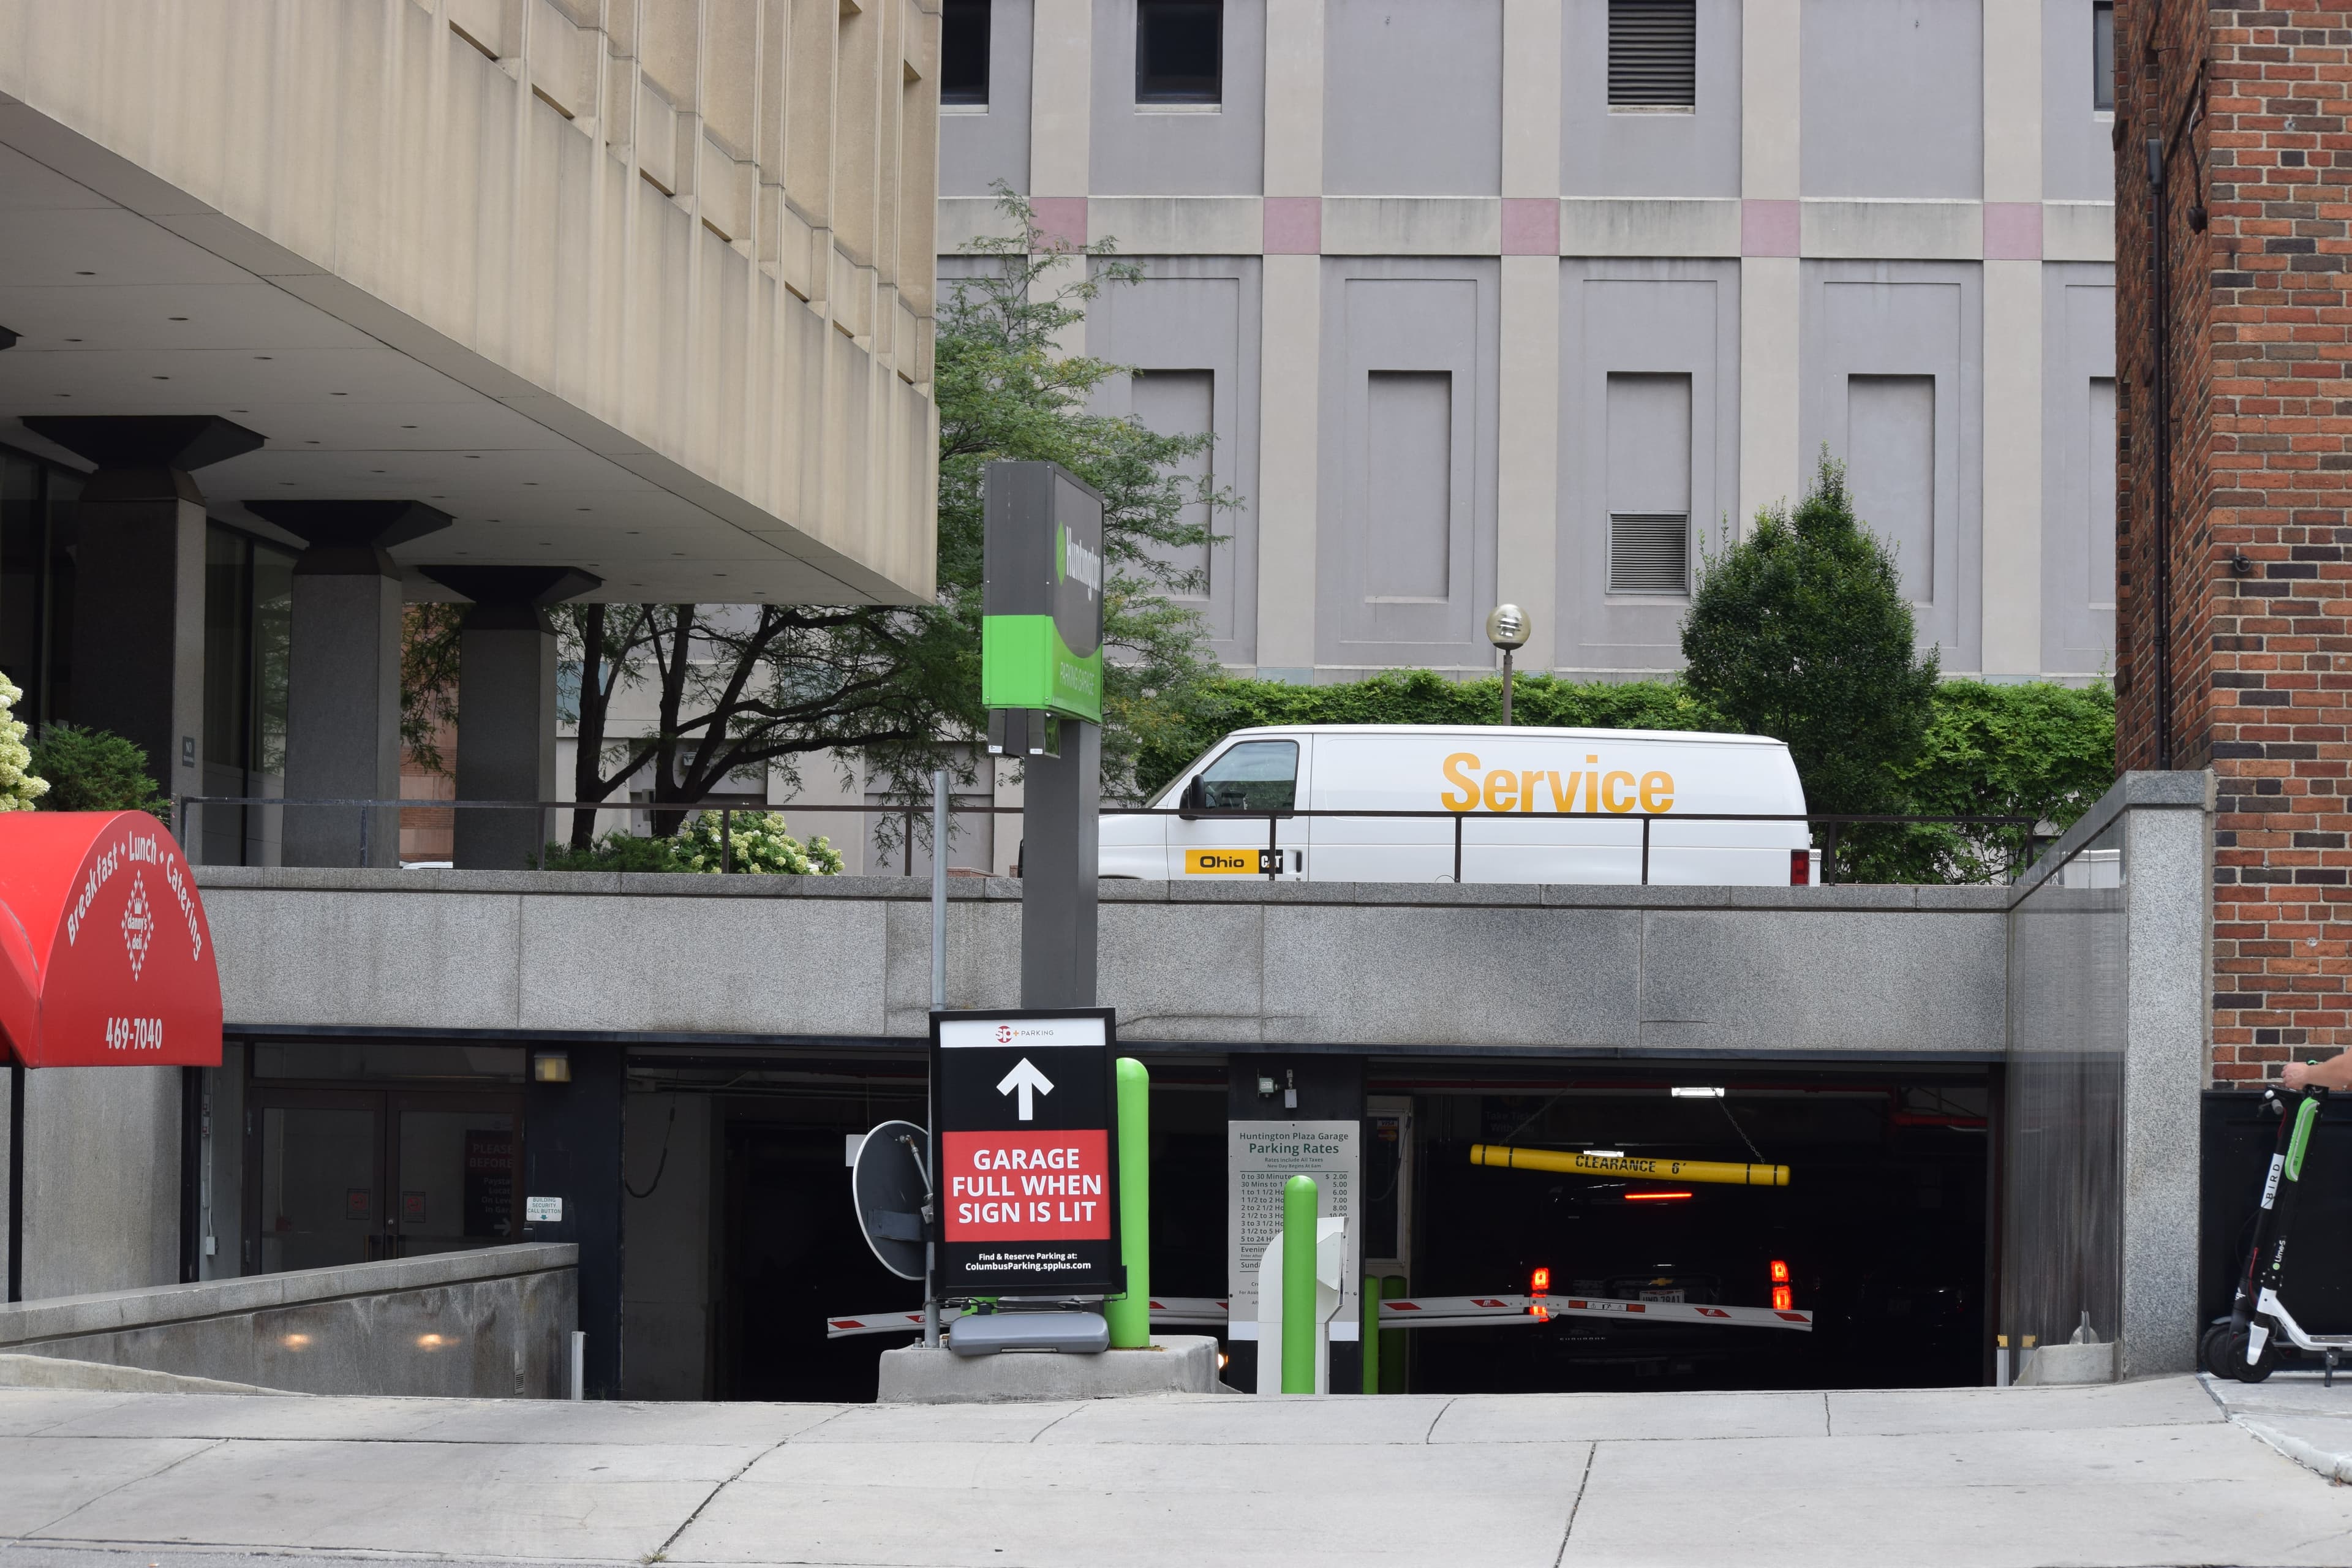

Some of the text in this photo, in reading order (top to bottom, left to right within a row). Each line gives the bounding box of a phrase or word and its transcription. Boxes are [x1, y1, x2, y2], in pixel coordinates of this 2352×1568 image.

[1066, 526, 1101, 601] Huntington
[1441, 752, 1675, 813] Service
[1200, 855, 1281, 868] Ohio CT
[67, 831, 202, 961] Breakfast Lunch Catering
[127, 913, 148, 933] danny's
[132, 933, 142, 950] deli
[105, 1017, 162, 1050] 469-7040
[1240, 1133, 1290, 1142] Huntington
[1318, 1133, 1349, 1142] Garage
[473, 1143, 513, 1154] PLEASE
[1250, 1143, 1339, 1156] Parking Rates
[470, 1158, 513, 1167] BEFORE
[973, 1148, 1080, 1170] GARAGE
[1575, 1155, 1687, 1175] CLEARANCE 6'
[952, 1174, 1101, 1197] FULL WHEN
[2266, 1164, 2280, 1199] BIRD
[959, 1201, 1096, 1224] SIGN IS LIT
[965, 1261, 1091, 1272] ColumbusParking.spplus.com
[1036, 1253, 1066, 1261] Parking
